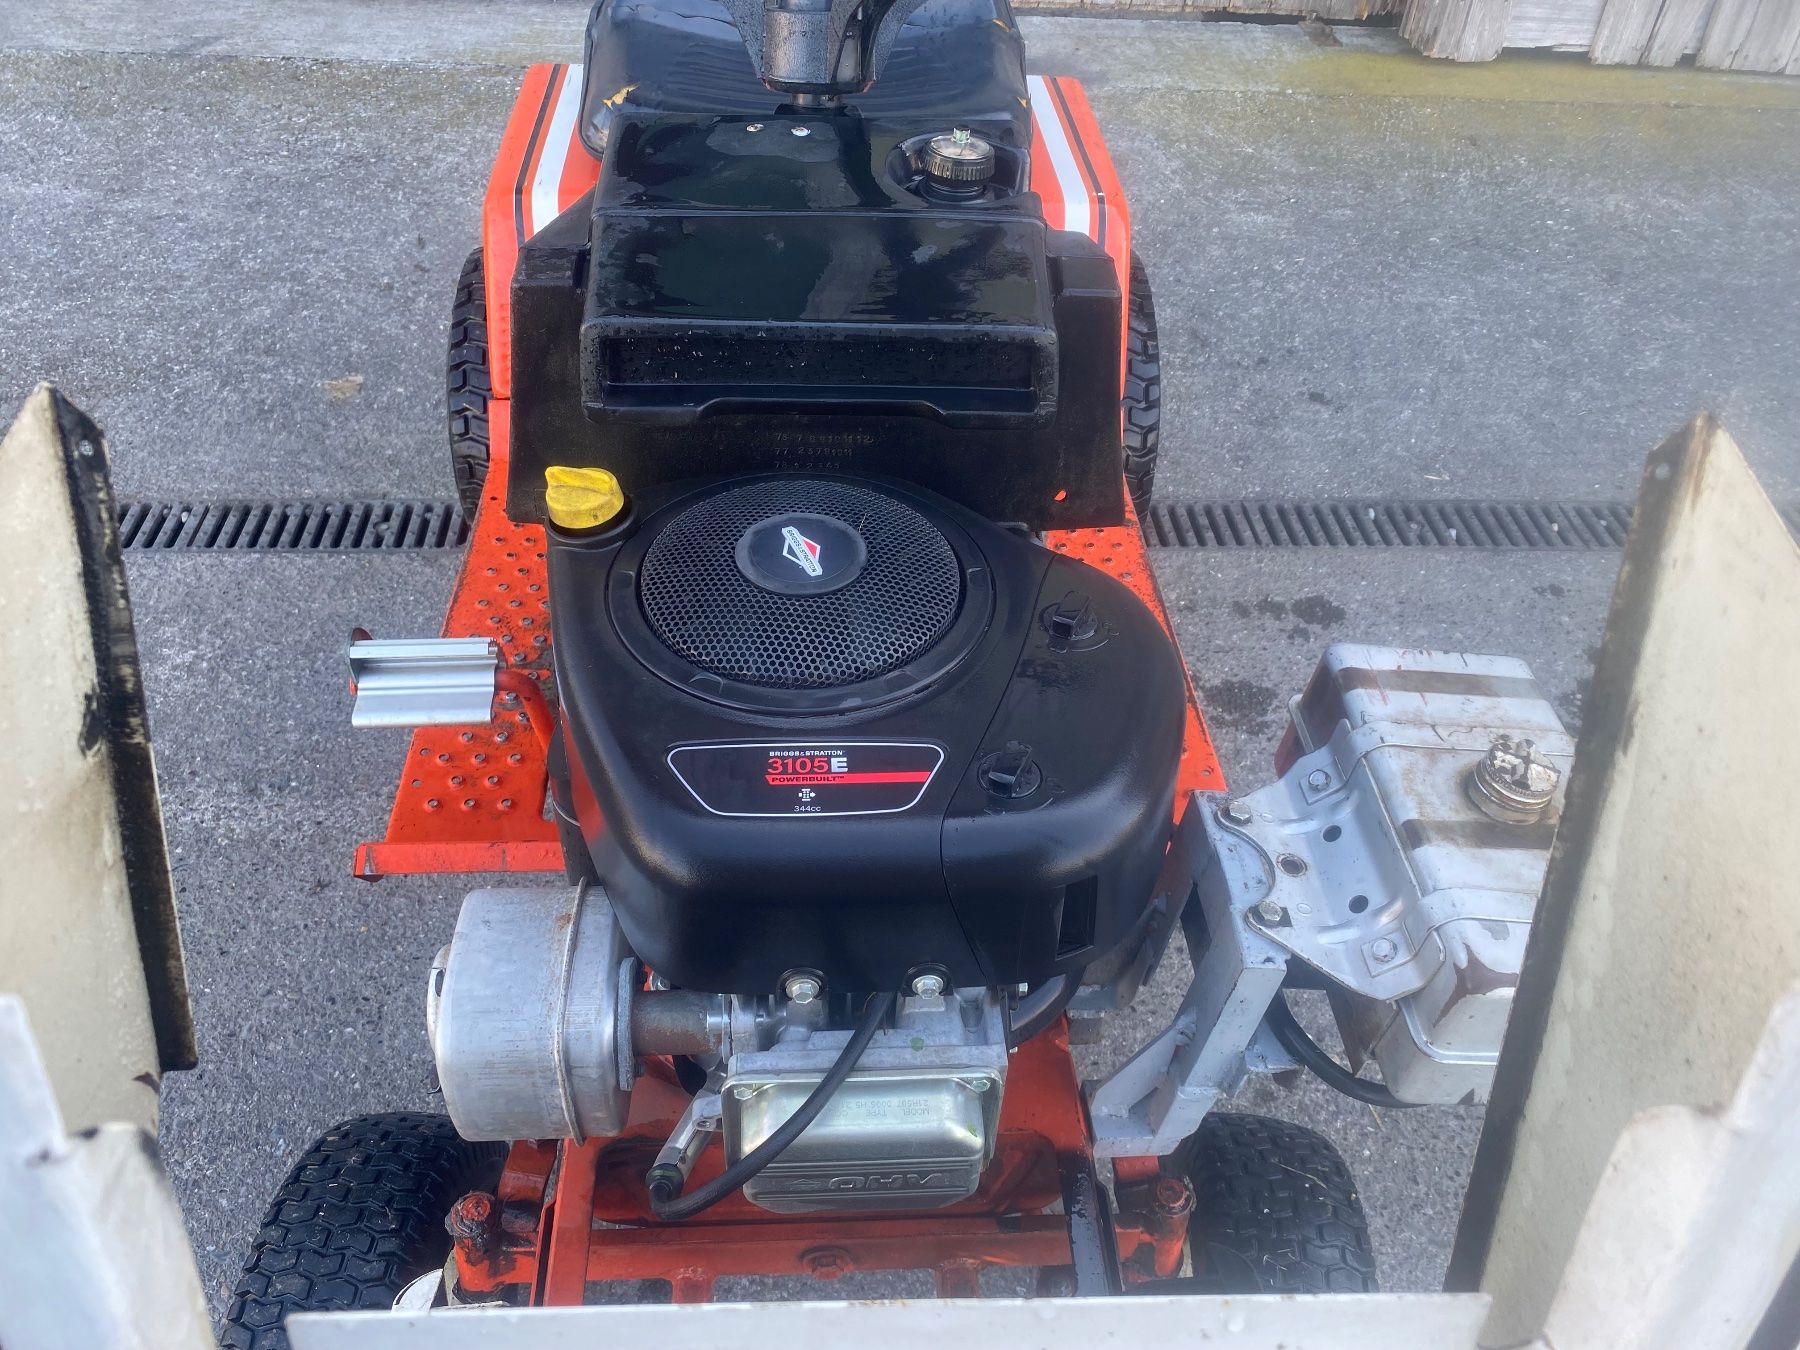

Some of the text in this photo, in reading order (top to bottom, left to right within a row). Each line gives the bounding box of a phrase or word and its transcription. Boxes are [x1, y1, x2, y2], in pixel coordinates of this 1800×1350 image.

[767, 757, 849, 773] 3105E
[865, 1107, 930, 1117] MODEL TYPE
[828, 1173, 943, 1190] OHV
